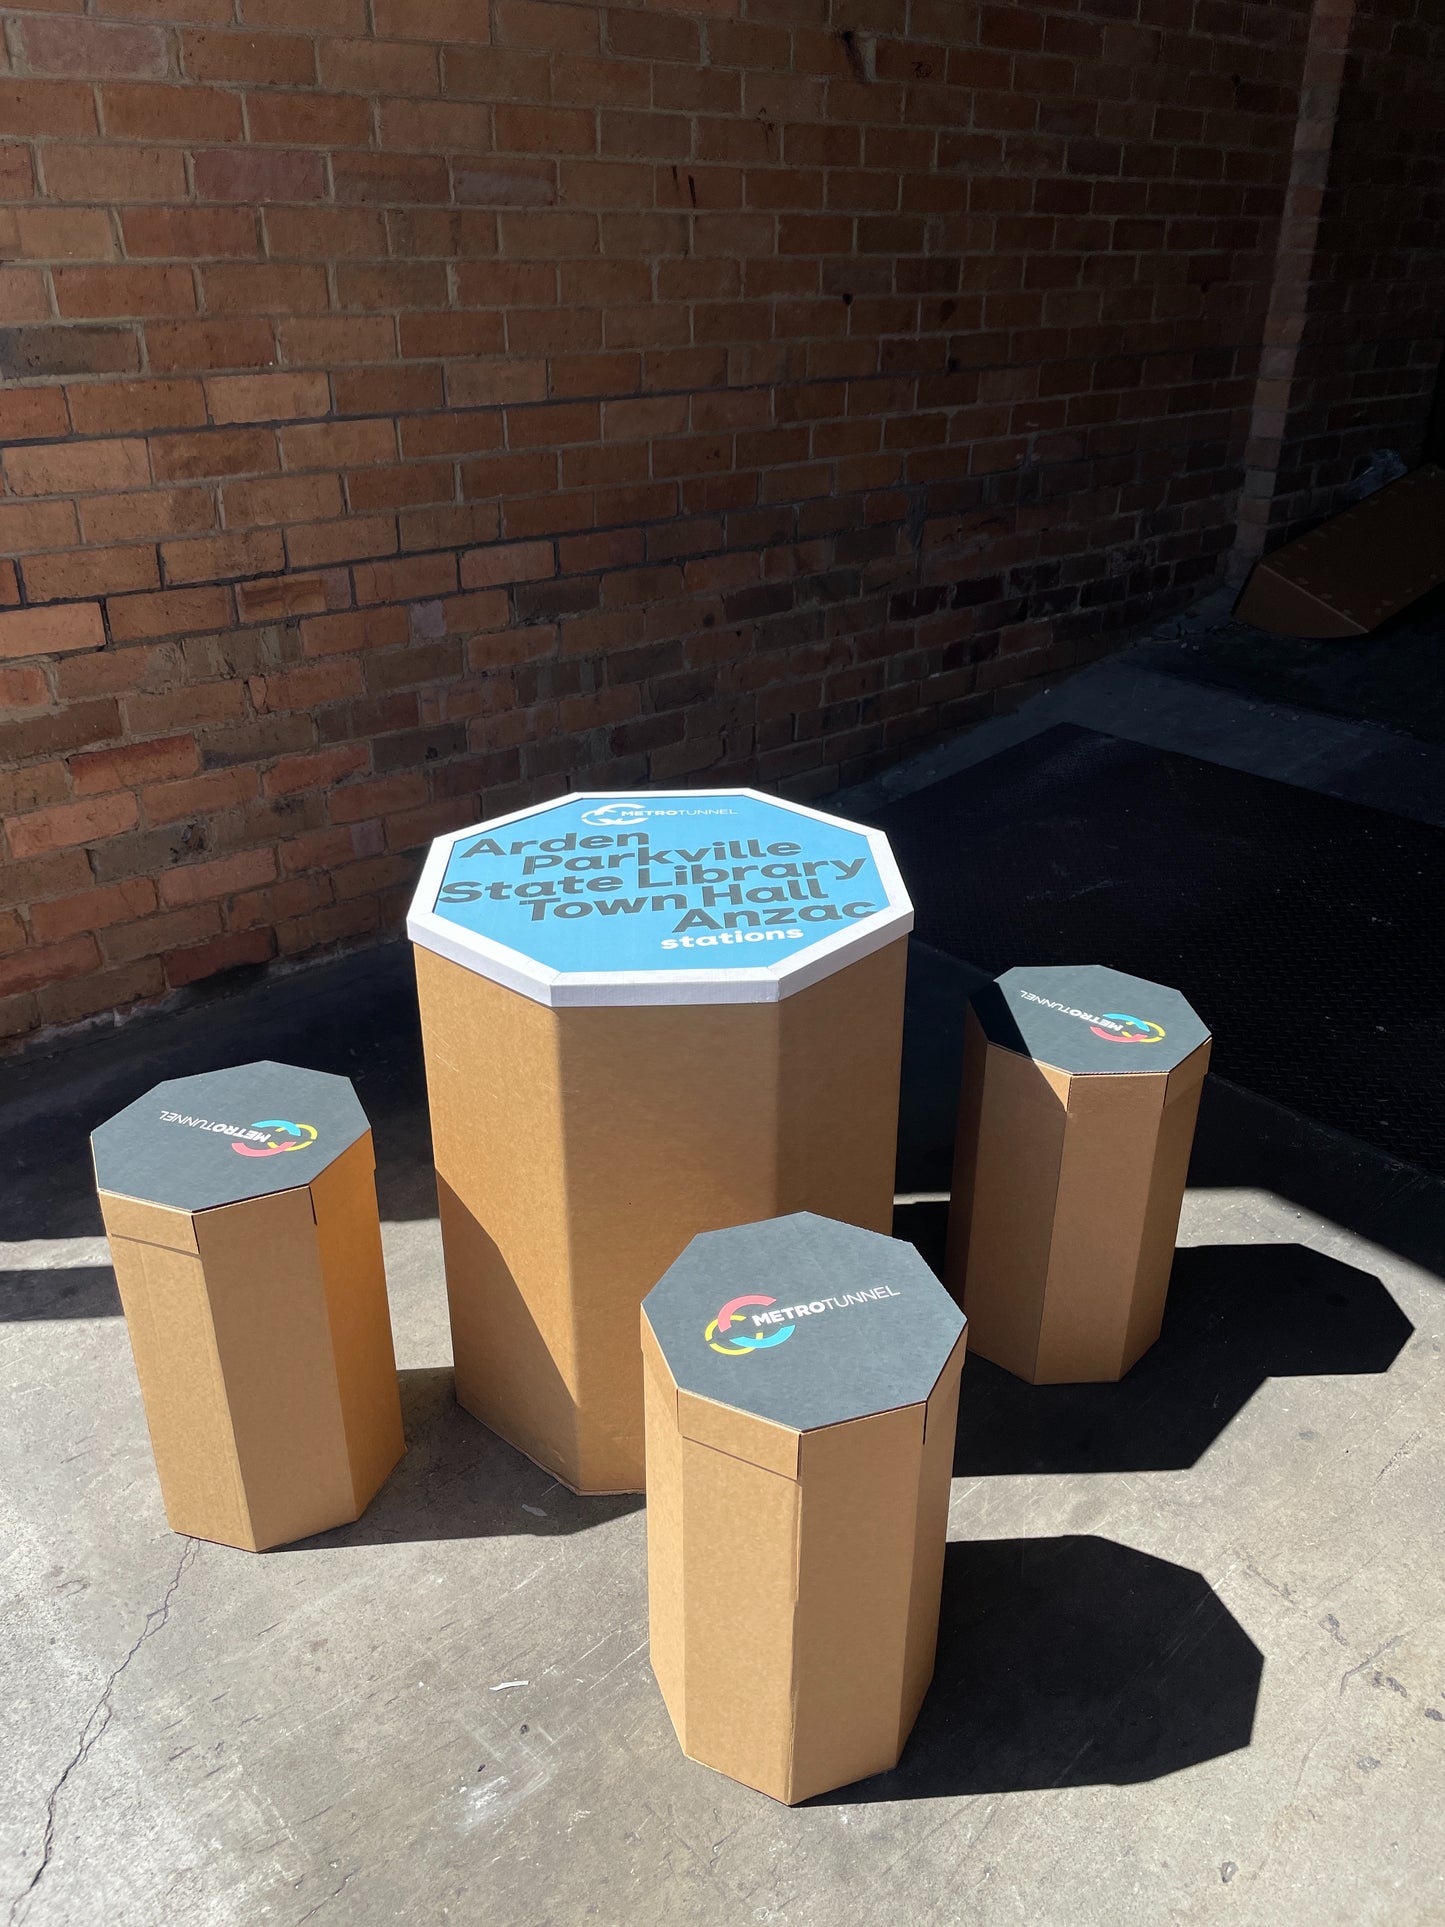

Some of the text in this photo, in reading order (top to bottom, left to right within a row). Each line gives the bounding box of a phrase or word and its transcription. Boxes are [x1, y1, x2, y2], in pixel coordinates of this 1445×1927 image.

[621, 807, 739, 818] METROTUNNEL
[459, 832, 649, 859] Arden
[522, 841, 803, 876] Parkville
[437, 857, 867, 904] State Library
[519, 877, 829, 922] Town Hall
[672, 901, 878, 933] Anzac
[660, 928, 804, 951] stations
[751, 1285, 901, 1327] METROTUNNEL
